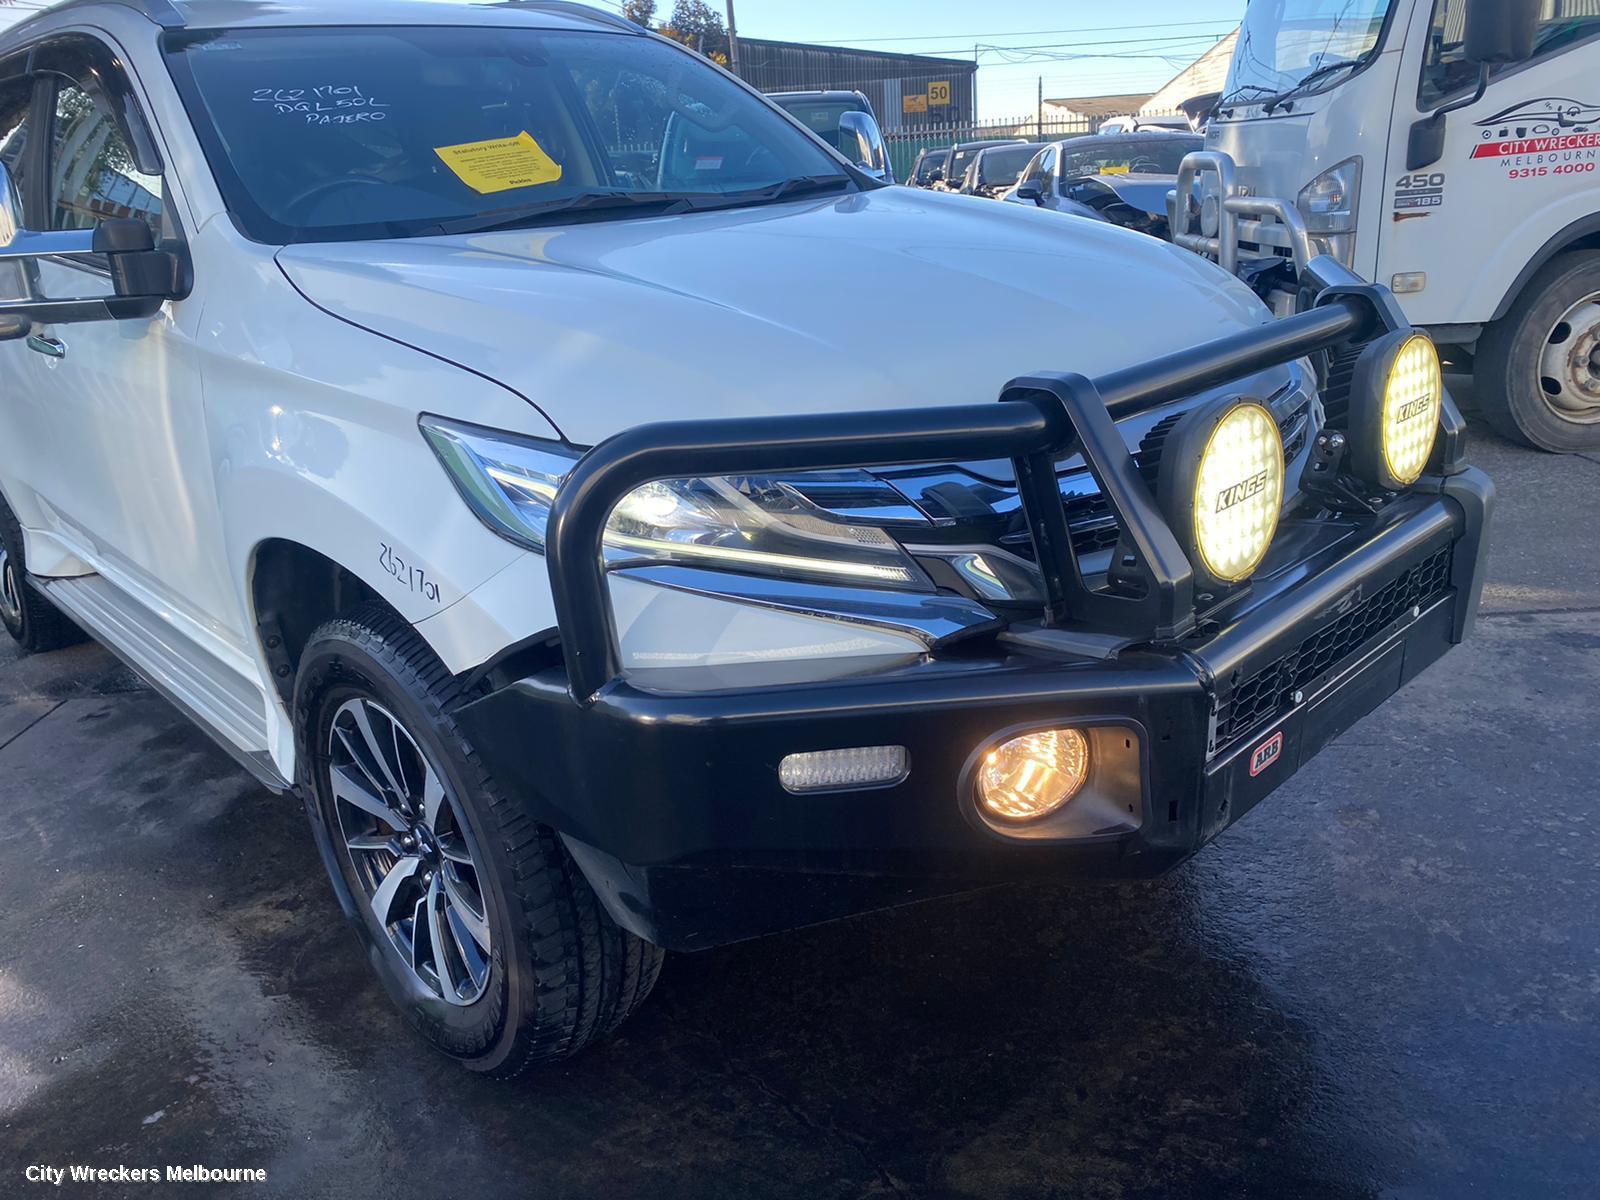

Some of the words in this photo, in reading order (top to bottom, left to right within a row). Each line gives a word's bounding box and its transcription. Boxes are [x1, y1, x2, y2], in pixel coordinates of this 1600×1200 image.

[930, 86, 948, 99] 50
[1499, 140, 1530, 155] CITY
[1500, 150, 1596, 167] MELBOURN
[1509, 166, 1547, 179] 9315
[1553, 162, 1595, 175] 4000
[1395, 173, 1445, 189] 450
[1397, 393, 1430, 424] KINGS
[1216, 469, 1267, 513] KINGS
[1255, 739, 1279, 769] ARB
